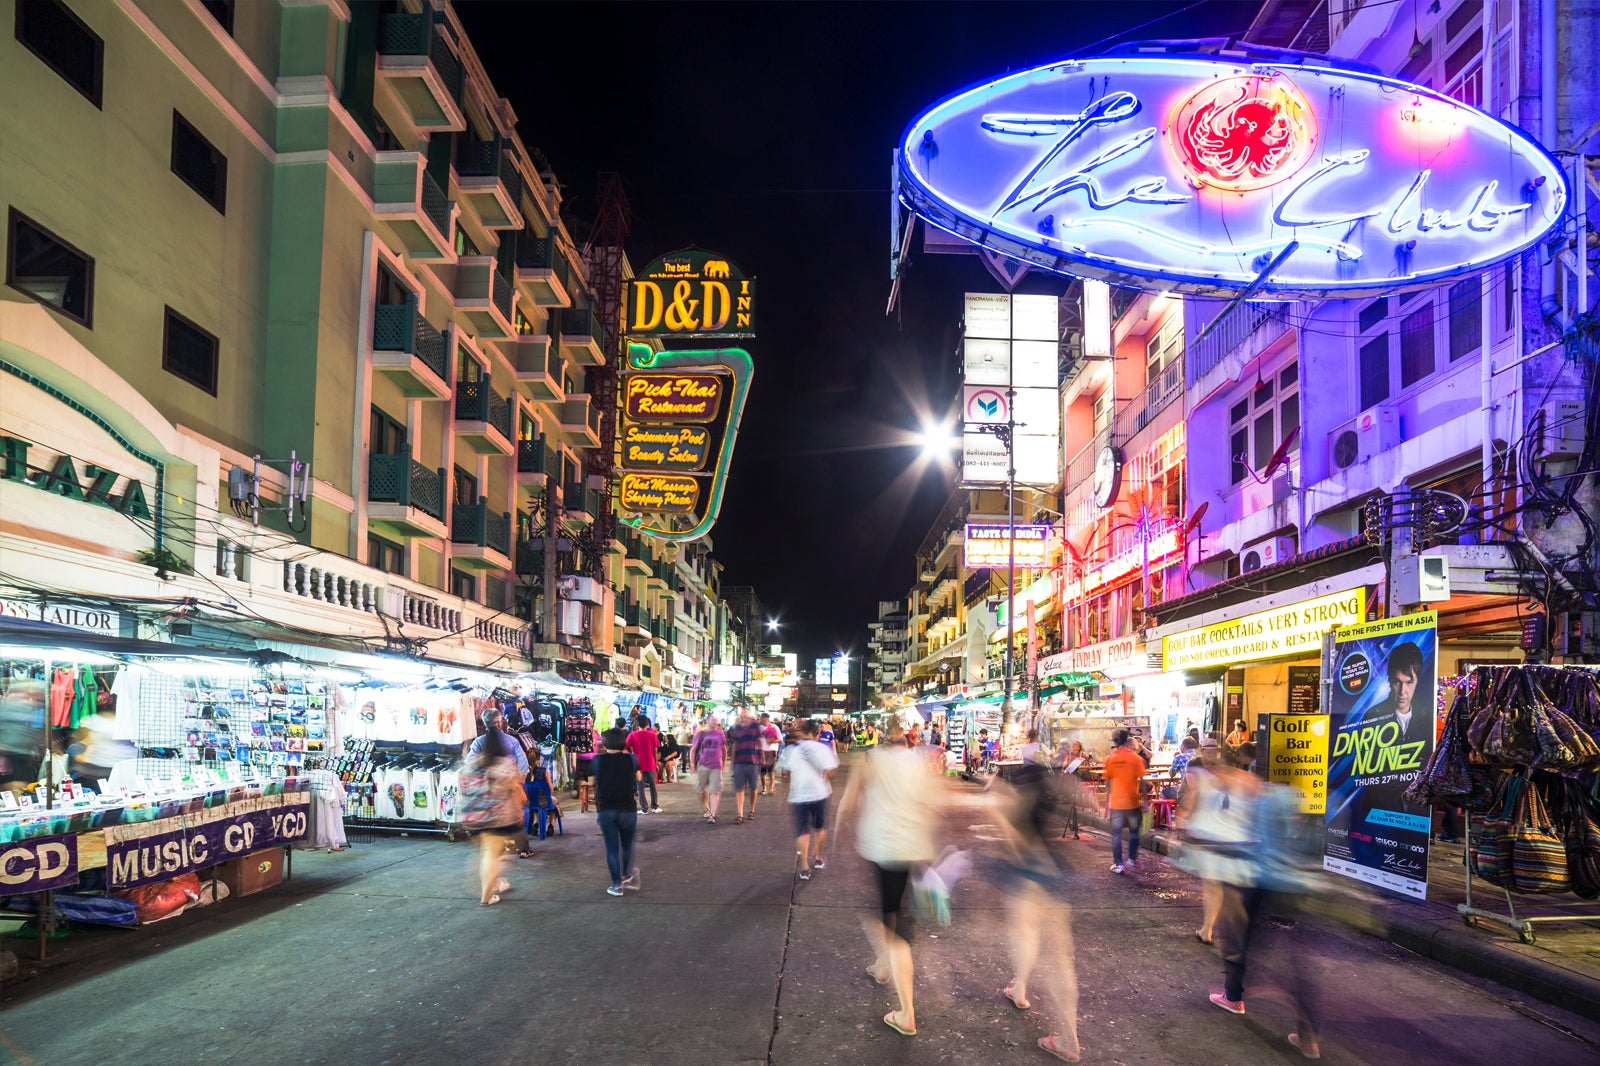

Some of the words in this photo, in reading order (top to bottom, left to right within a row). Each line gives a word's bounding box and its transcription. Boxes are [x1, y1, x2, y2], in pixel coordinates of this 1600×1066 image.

[982, 91, 1193, 222] The
[1273, 149, 1531, 232] Club
[665, 263, 675, 272] The
[677, 263, 690, 272] best
[632, 280, 730, 331] D&D
[737, 281, 751, 326] INN
[630, 379, 716, 397] Pick-Thai
[638, 398, 706, 414] Restaurant
[626, 427, 680, 446] Swimming
[679, 428, 706, 445] Pool
[629, 446, 664, 464] Beauty
[667, 448, 698, 462] Salon
[0, 436, 153, 521] LAZA
[626, 477, 649, 489] Thai
[650, 479, 696, 495] Massage
[625, 490, 663, 507] Shopping
[664, 492, 692, 505] Plaza
[971, 530, 1000, 538] TASTE
[1015, 530, 1042, 539] INDIA
[37, 602, 111, 629] TAILOR
[1168, 636, 1187, 652] GOLF
[1190, 632, 1206, 648] BAR
[1209, 620, 1263, 644] COCKTAILS
[1269, 610, 1300, 631] VERY
[1303, 598, 1359, 625] STRONG
[1338, 630, 1350, 638] FOR
[1352, 628, 1365, 636] THE
[1366, 624, 1385, 633] FIRST
[1387, 621, 1403, 629] TIME
[1415, 616, 1433, 624] ASIA
[1076, 649, 1101, 668] INDIAN
[1109, 641, 1132, 663] FOOD
[1190, 651, 1202, 662] NOT
[1205, 647, 1230, 660] CHECK
[1232, 646, 1241, 656] ID
[1243, 640, 1268, 654] CARD
[1271, 640, 1280, 648] &
[1285, 629, 1323, 647] RESTA
[1273, 719, 1310, 733] Golf
[1286, 738, 1312, 749] Bar
[1332, 721, 1399, 757] DARIO
[1275, 754, 1322, 763] Cocktail
[1273, 768, 1292, 776] VERY
[1294, 768, 1323, 776] STRONG
[1355, 776, 1380, 787] THURS
[1382, 774, 1398, 784] 27TH
[1400, 772, 1419, 782] NOV
[112, 835, 208, 885] MUSIC
[224, 821, 254, 853] CD
[0, 842, 70, 884] CD
